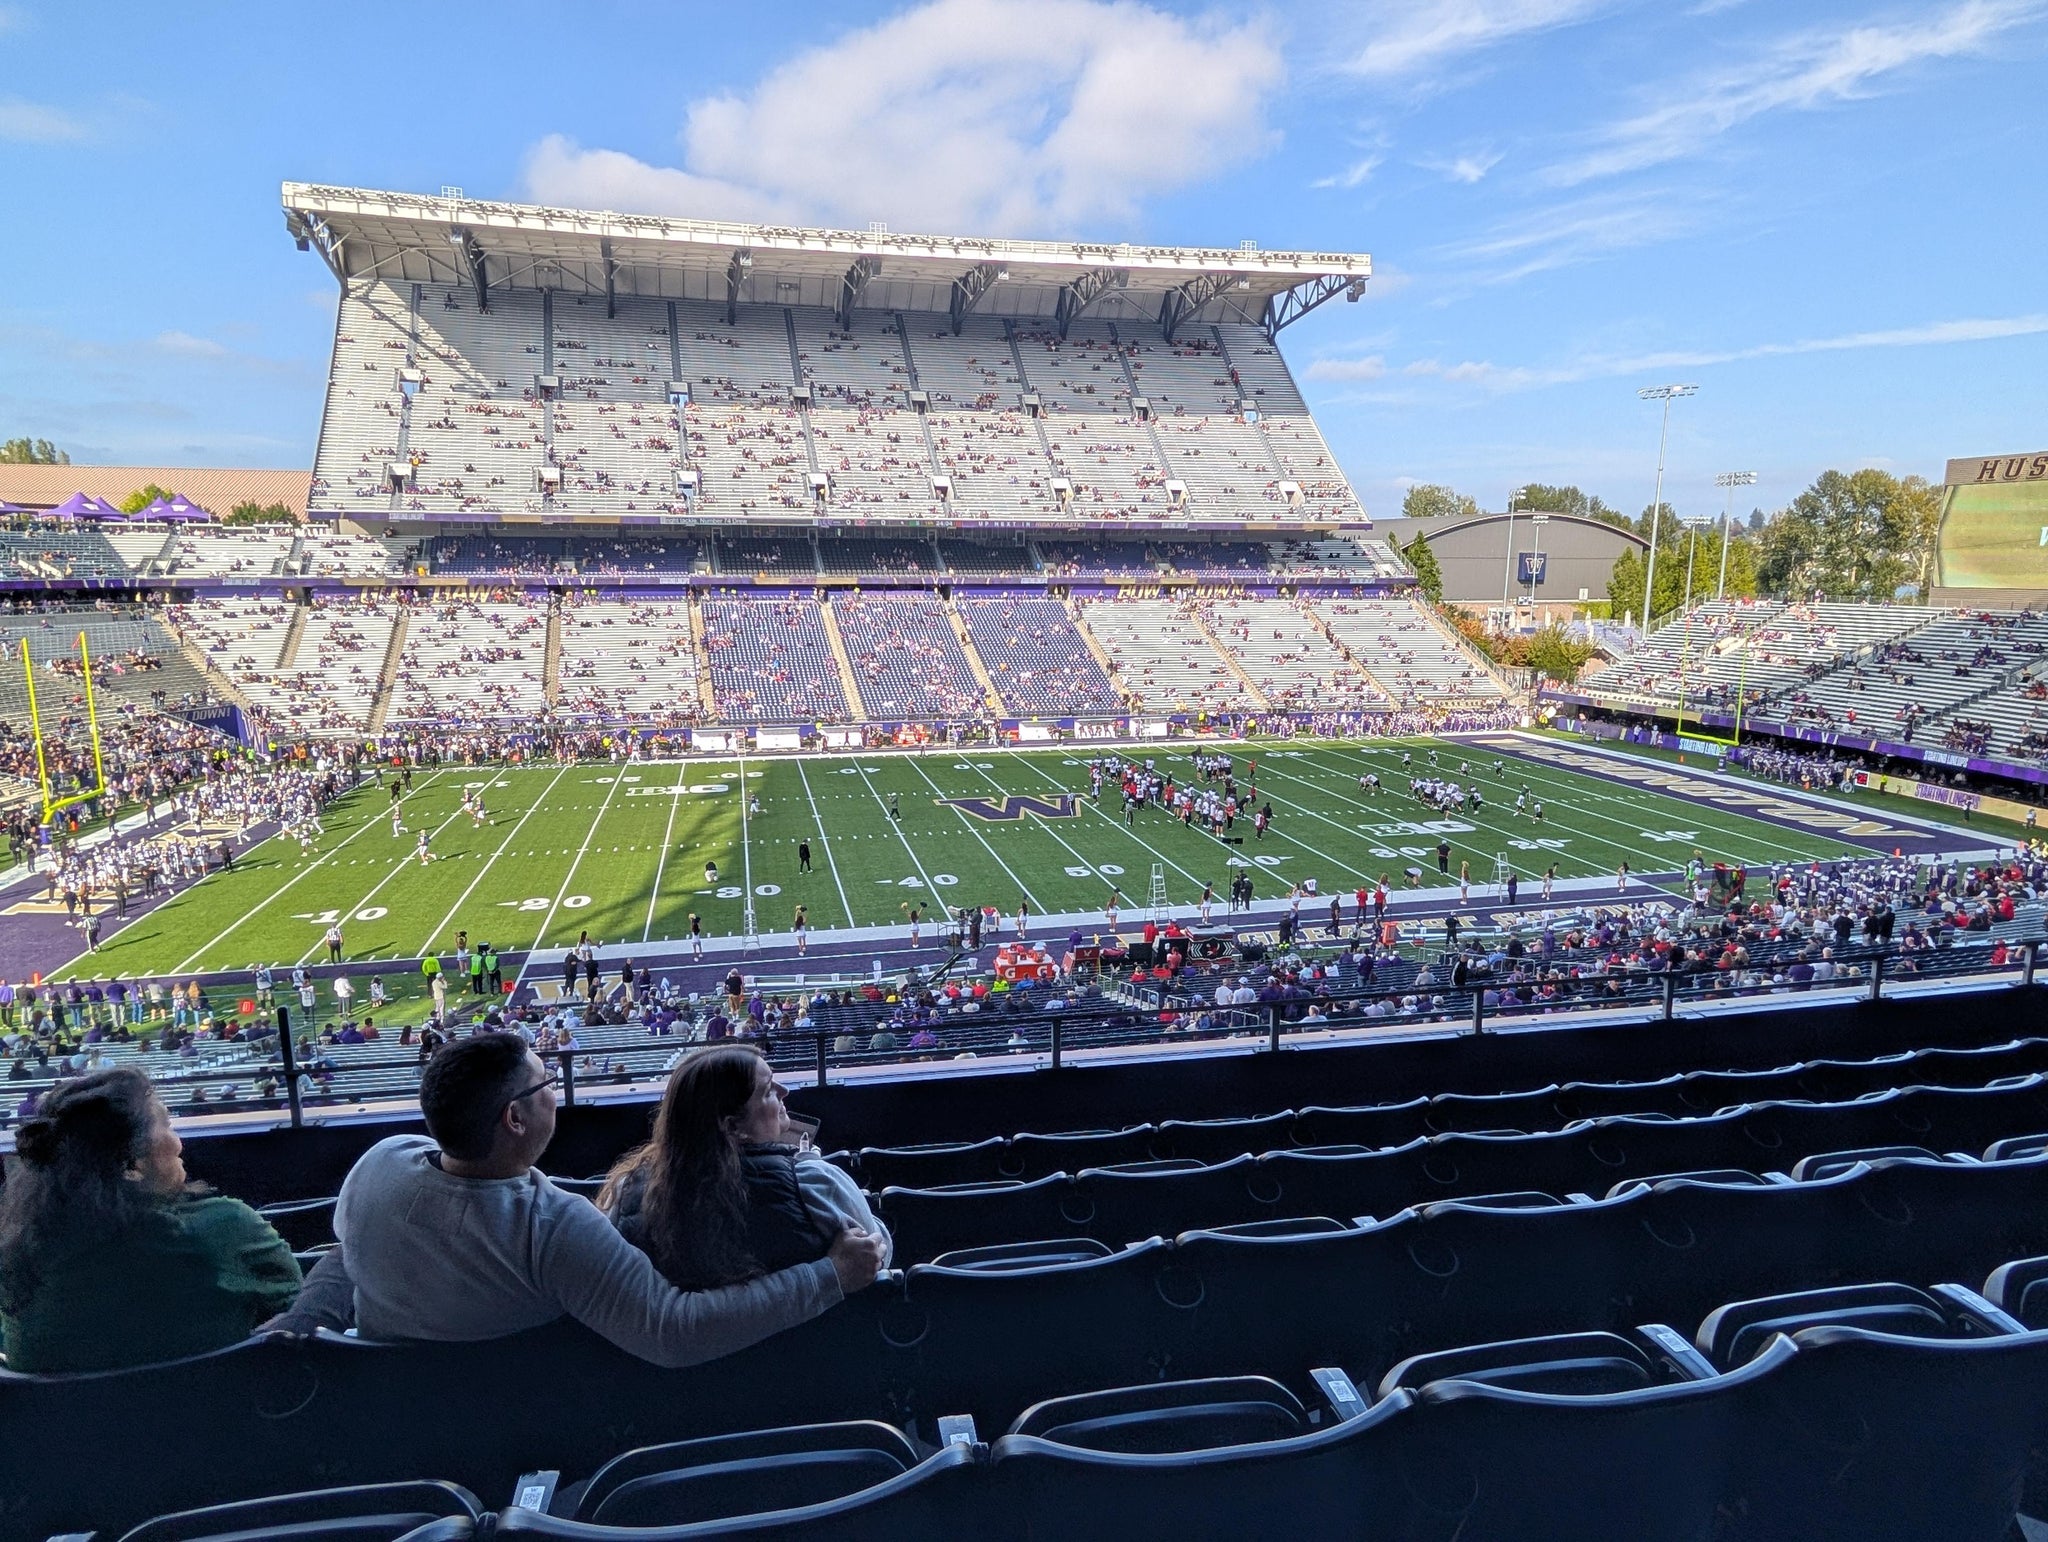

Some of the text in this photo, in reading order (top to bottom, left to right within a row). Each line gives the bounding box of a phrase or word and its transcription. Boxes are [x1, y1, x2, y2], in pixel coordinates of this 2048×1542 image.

[1975, 456, 2048, 482] HUS
[1525, 558, 1544, 574] W
[192, 707, 231, 721] DOWN!
[1915, 784, 1981, 809] STARTING LINEPS
[932, 793, 1091, 822] W
[1640, 830, 1696, 842] 10
[1507, 839, 1566, 850] 20
[1226, 855, 1281, 868] 40
[1064, 864, 1125, 877] 50
[898, 874, 959, 888] 40
[716, 884, 781, 899] 30
[518, 896, 592, 911] 20
[310, 907, 388, 924] 10
[1005, 967, 1016, 979] G
[1037, 966, 1047, 976] G
